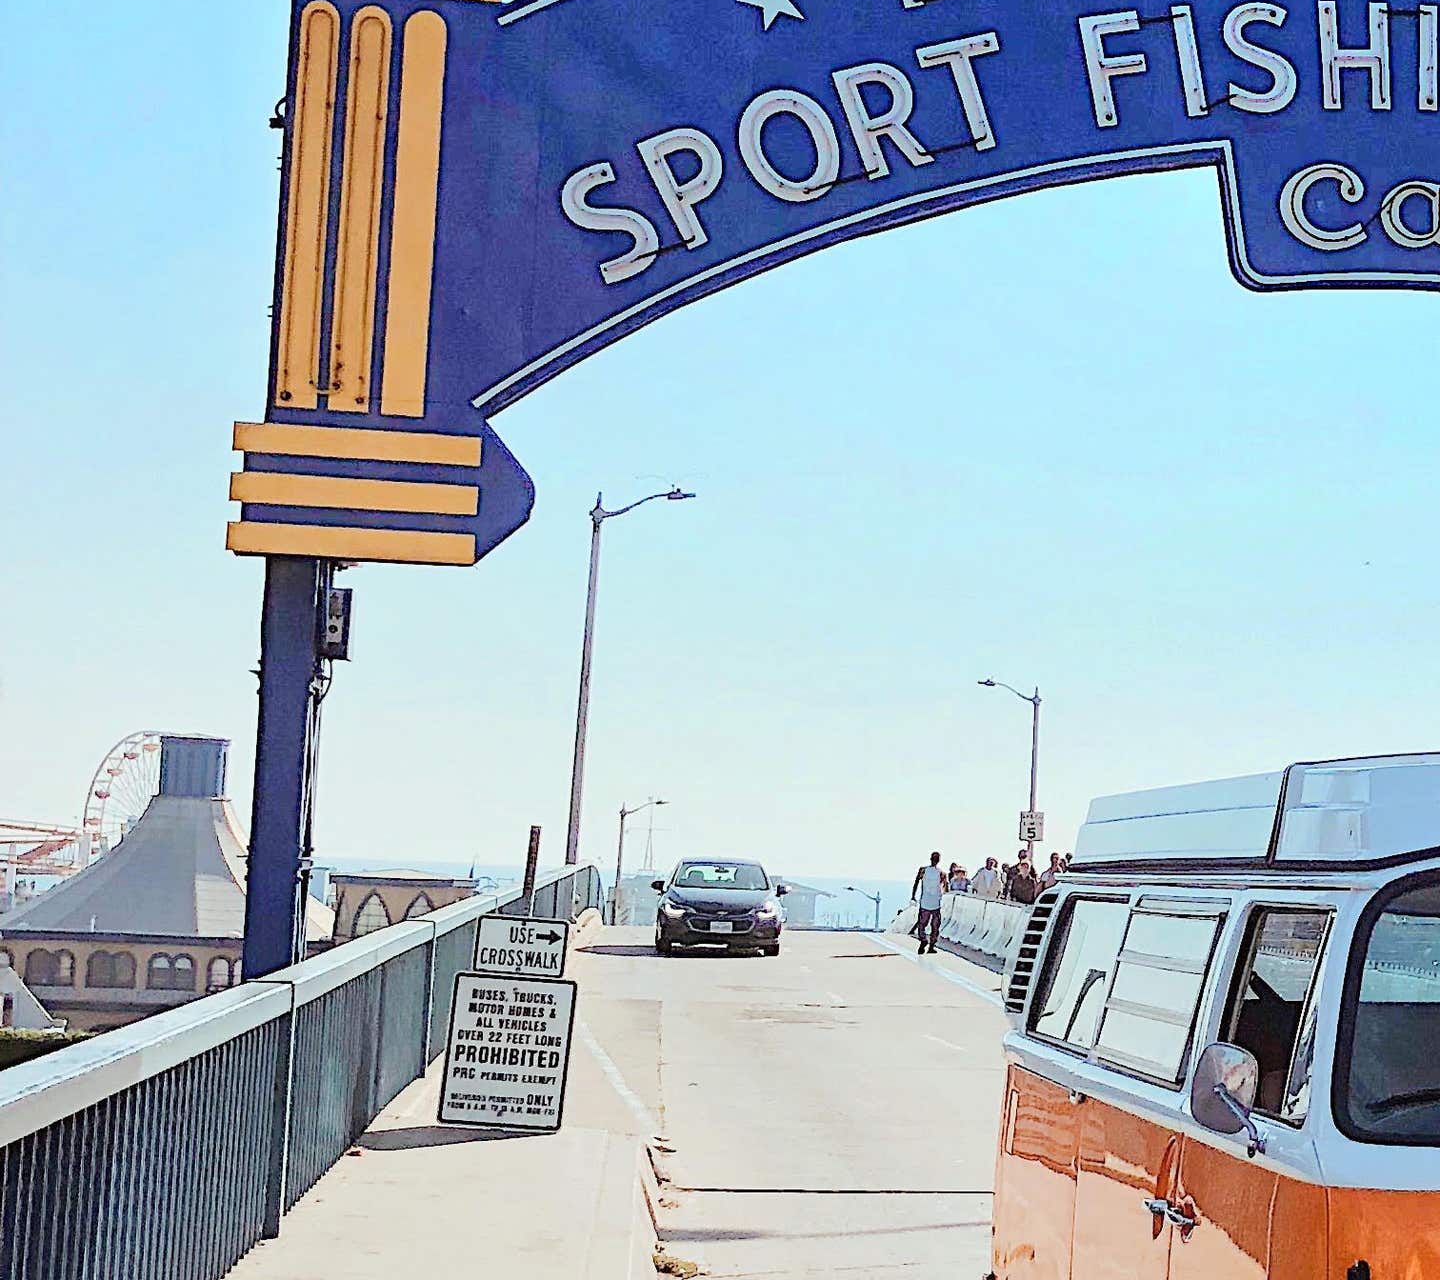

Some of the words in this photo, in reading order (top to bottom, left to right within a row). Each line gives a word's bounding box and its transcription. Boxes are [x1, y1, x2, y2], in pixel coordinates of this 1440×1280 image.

[561, 32, 1000, 284] SPORT
[1027, 827, 1036, 839] 5
[510, 926, 535, 944] USE
[480, 947, 558, 969] CROSSWALK
[468, 1002, 504, 1015] MOTOR
[508, 1005, 545, 1017] HOMES
[549, 1008, 556, 1018] &
[476, 1017, 494, 1028] ALL
[498, 1018, 547, 1032] VEHICLES
[457, 1029, 483, 1040] OVER
[488, 1031, 502, 1042] 22
[506, 1032, 531, 1044] FEET
[535, 1035, 562, 1047] LONG
[454, 1044, 560, 1068] PROHIBITED
[526, 1094, 554, 1106] ONLY
